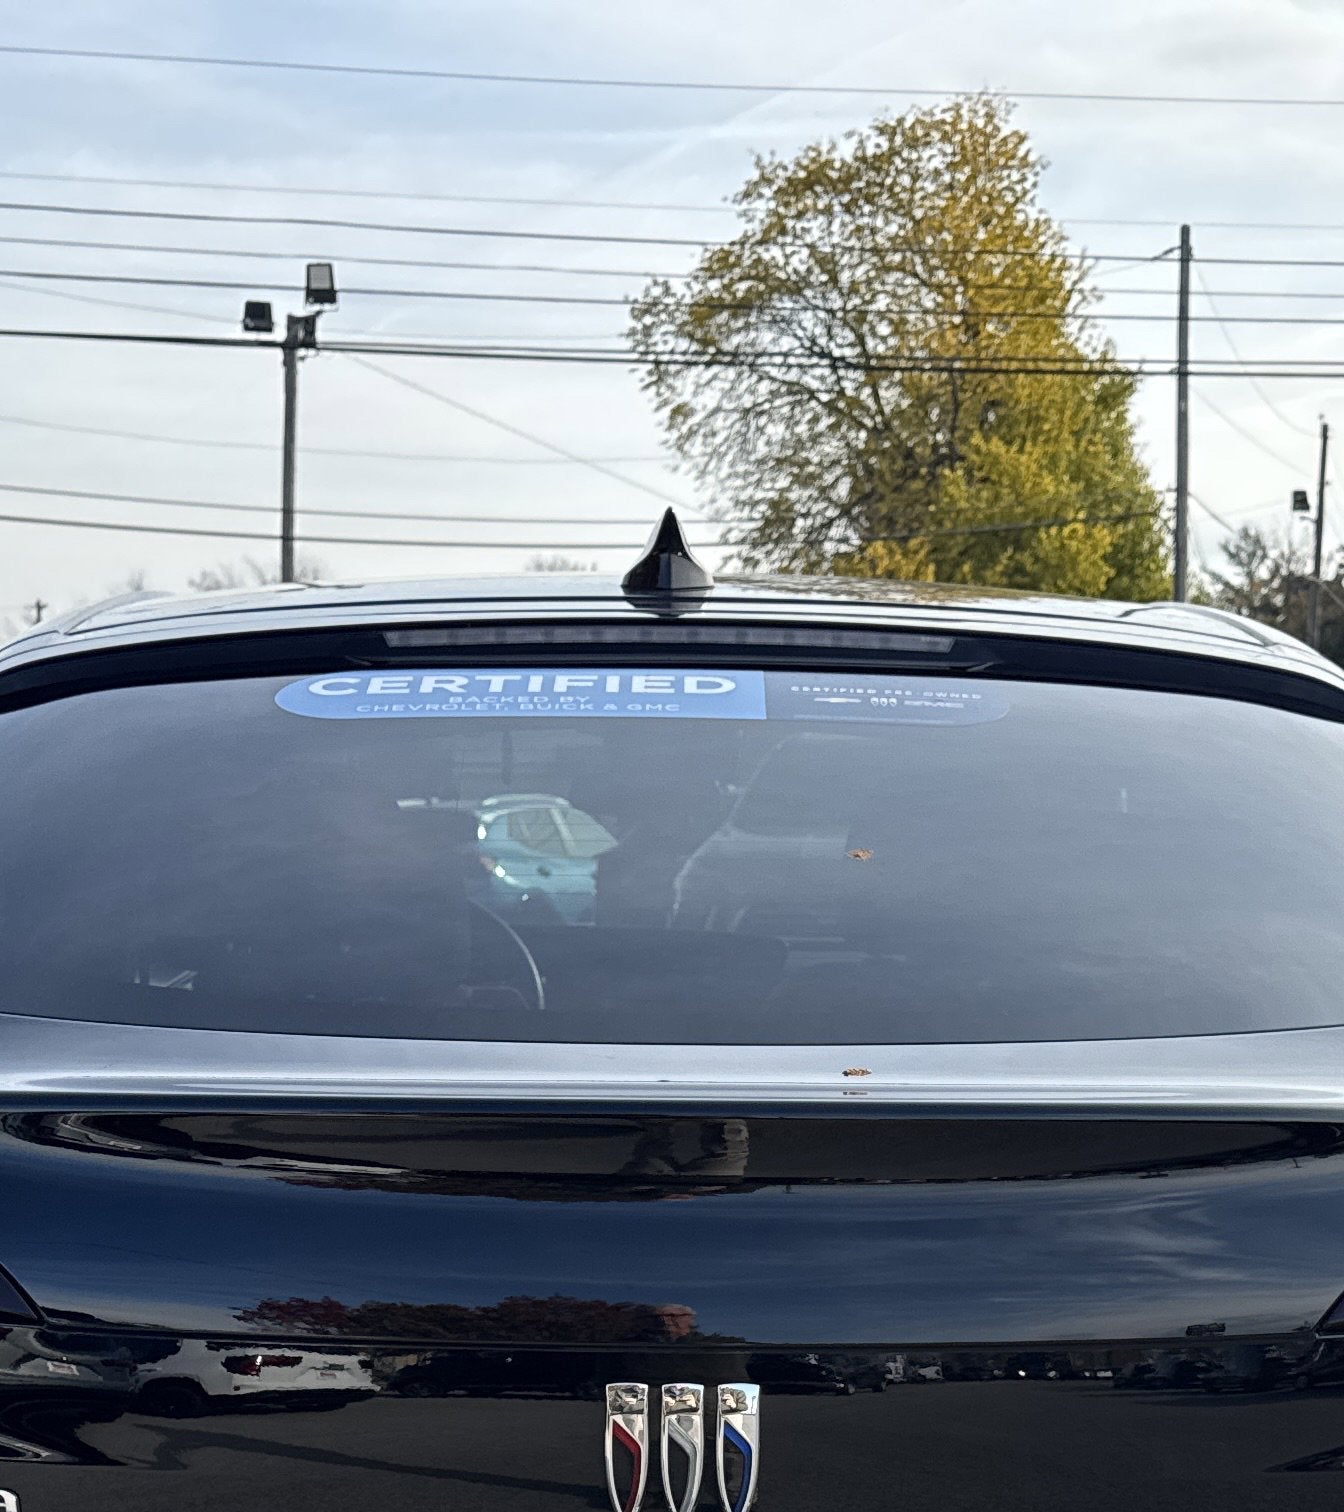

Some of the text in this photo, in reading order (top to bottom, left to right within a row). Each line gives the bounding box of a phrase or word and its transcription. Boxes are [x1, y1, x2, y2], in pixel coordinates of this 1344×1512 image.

[308, 675, 736, 696] CERTIFIED
[449, 695, 591, 704] BACKED BY
[356, 702, 681, 713] CHEVROLET, BUICK & GMC
